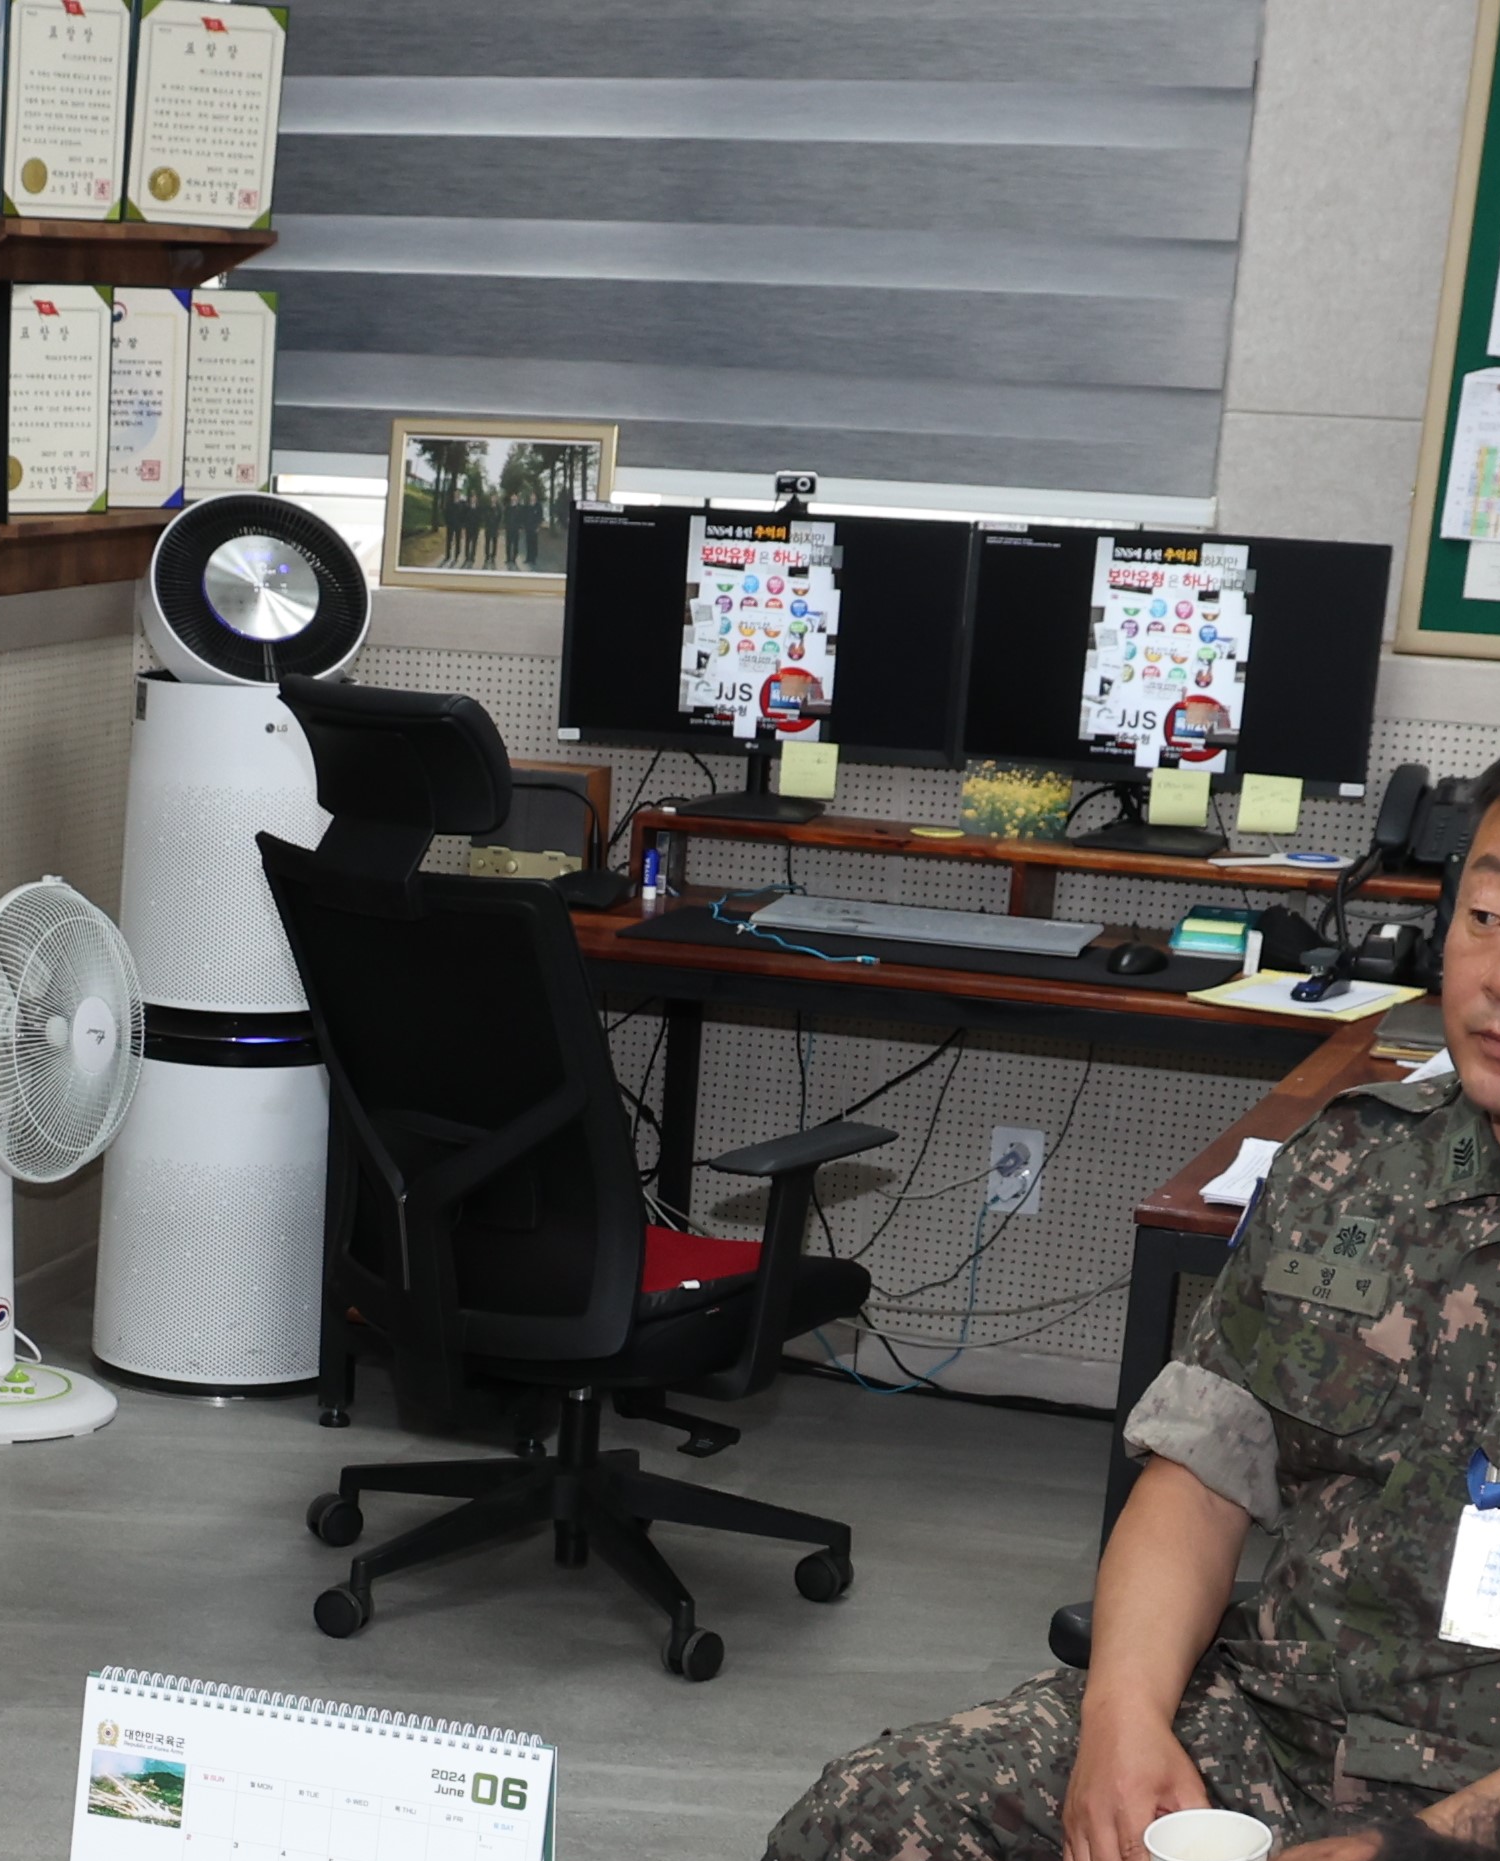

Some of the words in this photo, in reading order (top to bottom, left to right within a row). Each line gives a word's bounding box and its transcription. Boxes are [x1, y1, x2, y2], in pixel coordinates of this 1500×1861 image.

[702, 546, 757, 565] 보안유형
[1107, 568, 1165, 587] 보안유형
[1312, 1285, 1332, 1300] OH
[124, 1728, 186, 1750] 대한민국육군
[210, 1775, 225, 1783] SUN
[257, 1782, 273, 1792] MON
[306, 1790, 320, 1799] TUE
[352, 1798, 369, 1807] WED
[402, 1806, 417, 1815] THU
[453, 1815, 464, 1823] FRI
[431, 1768, 467, 1784] 2024
[471, 1771, 528, 1811] 06
[434, 1784, 465, 1798] June
